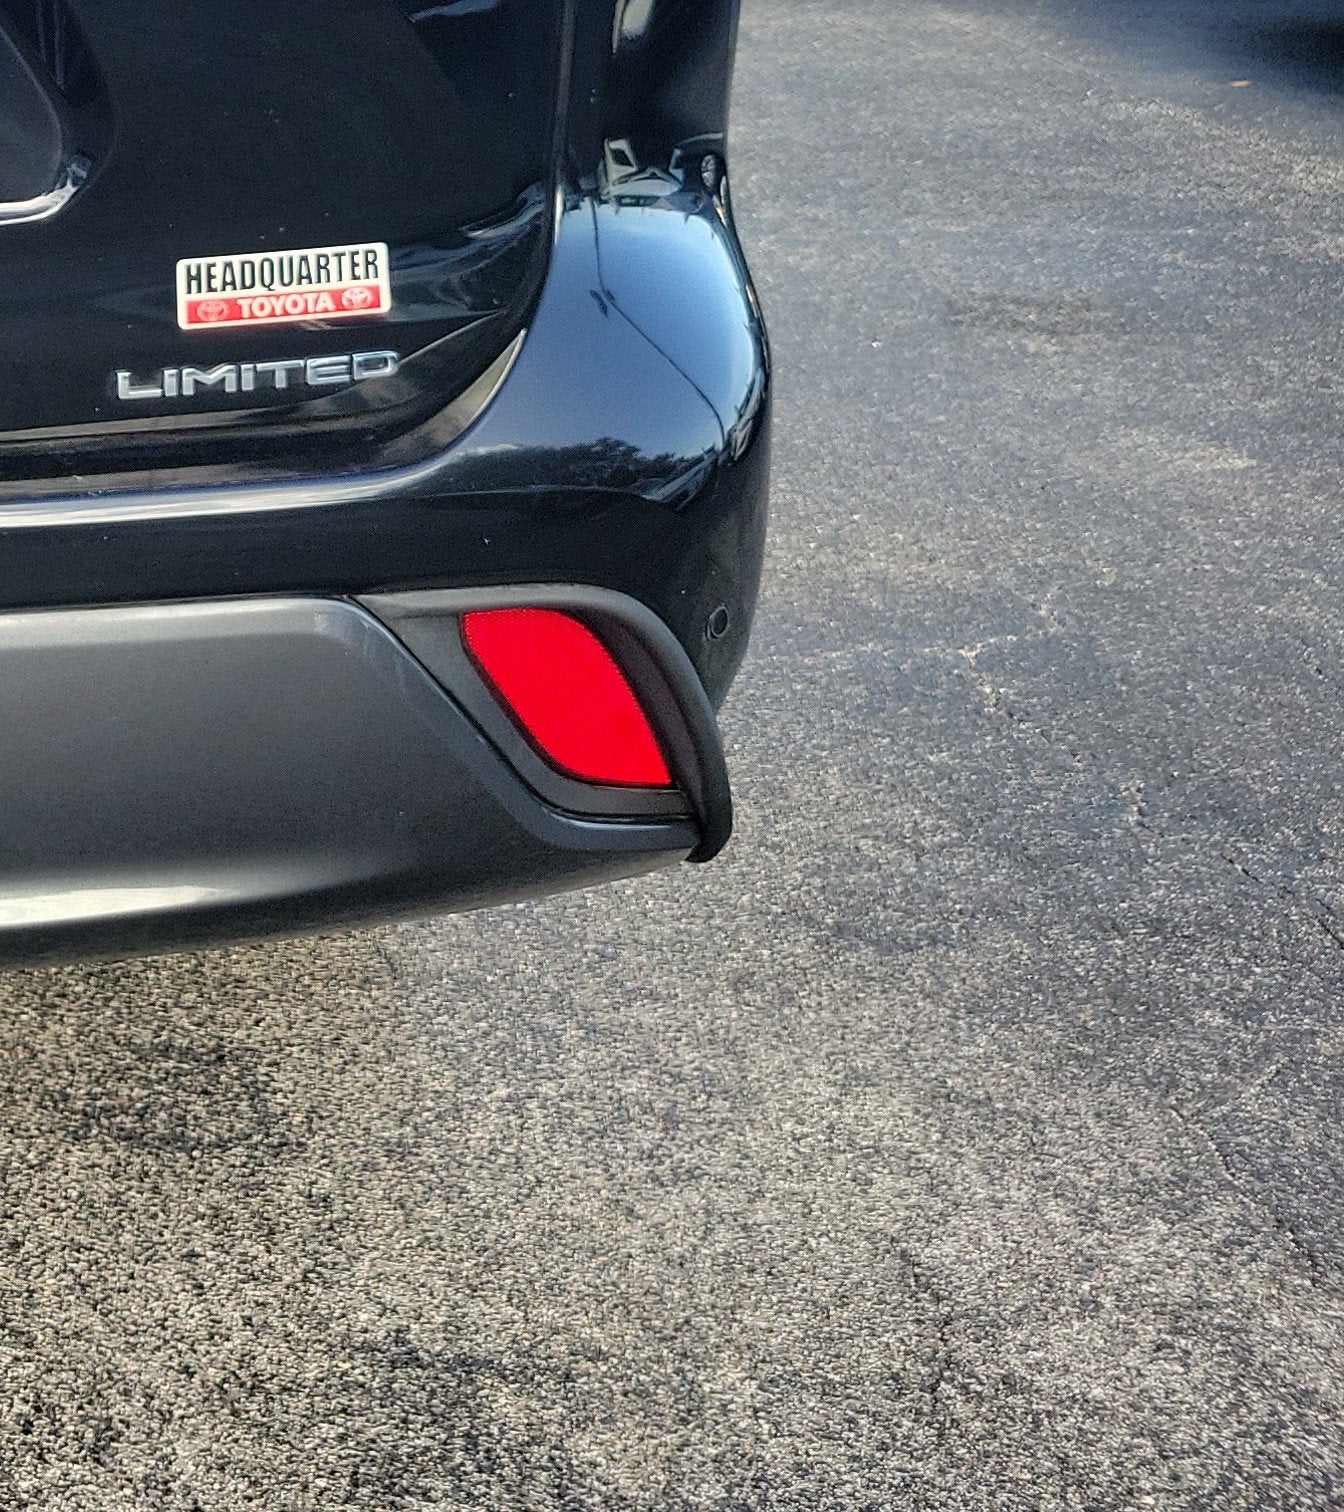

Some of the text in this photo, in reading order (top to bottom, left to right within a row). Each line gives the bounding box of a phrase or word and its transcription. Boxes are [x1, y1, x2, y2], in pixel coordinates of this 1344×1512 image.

[184, 248, 380, 295] HEADQUARTER
[236, 291, 335, 319] TOYOTA
[115, 350, 400, 400] LIMITED
